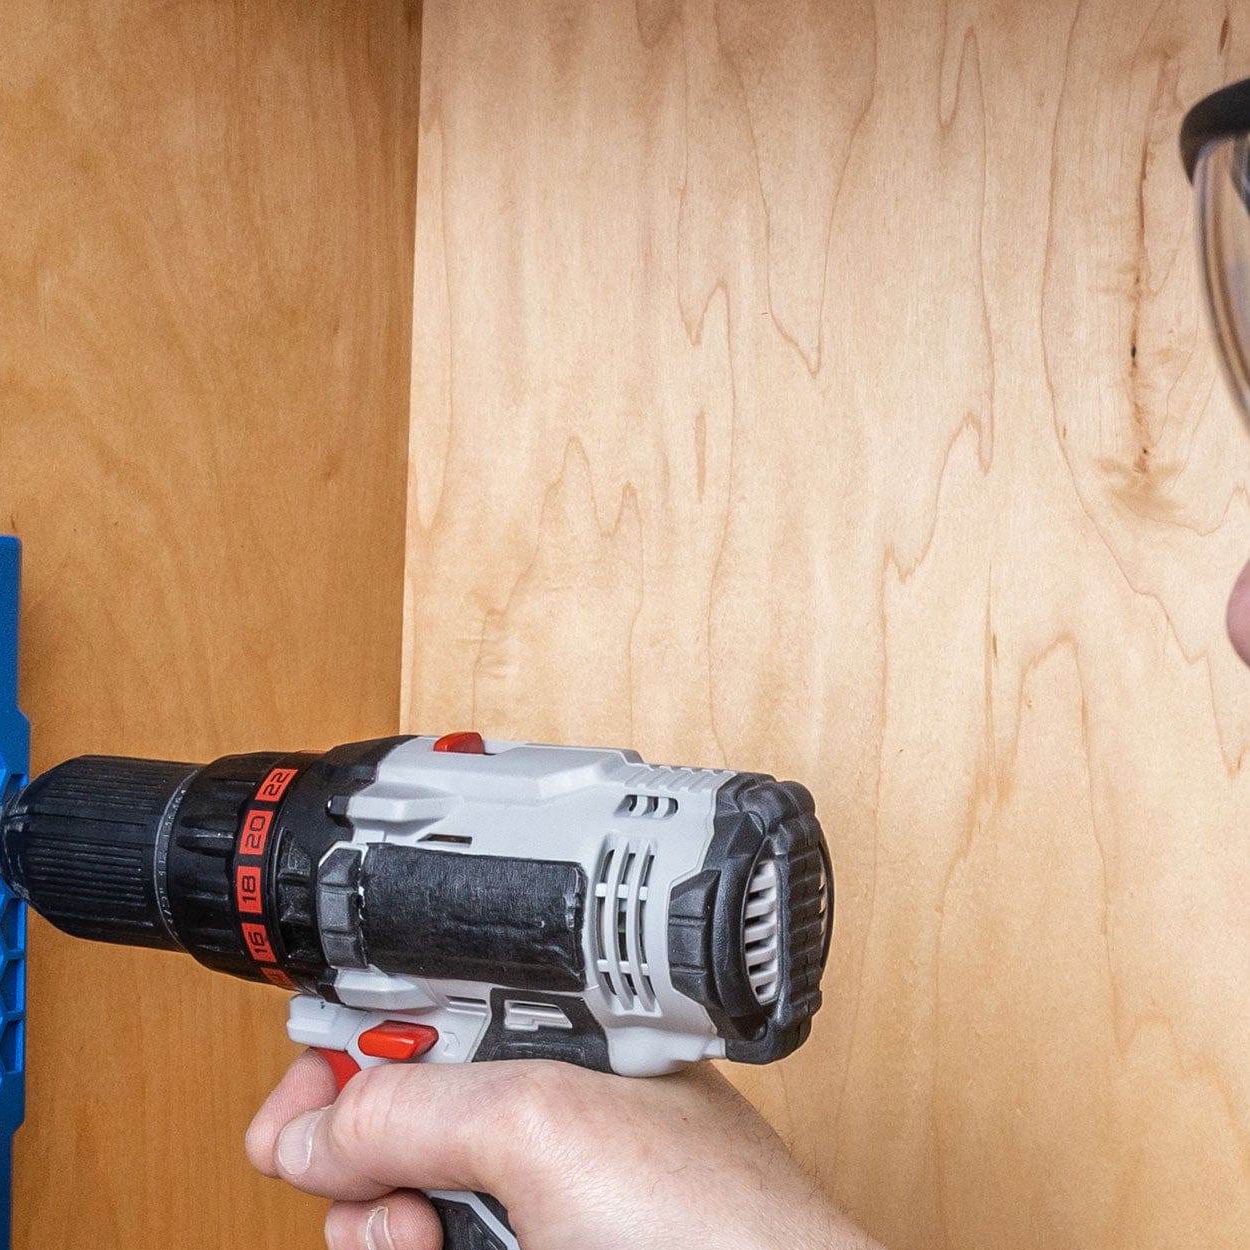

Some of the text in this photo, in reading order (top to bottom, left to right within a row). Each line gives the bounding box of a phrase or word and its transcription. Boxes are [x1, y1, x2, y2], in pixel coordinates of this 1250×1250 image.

[263, 772, 290, 796] 22
[245, 815, 266, 848] 20
[241, 875, 257, 903] 18
[248, 931, 268, 954] 16
